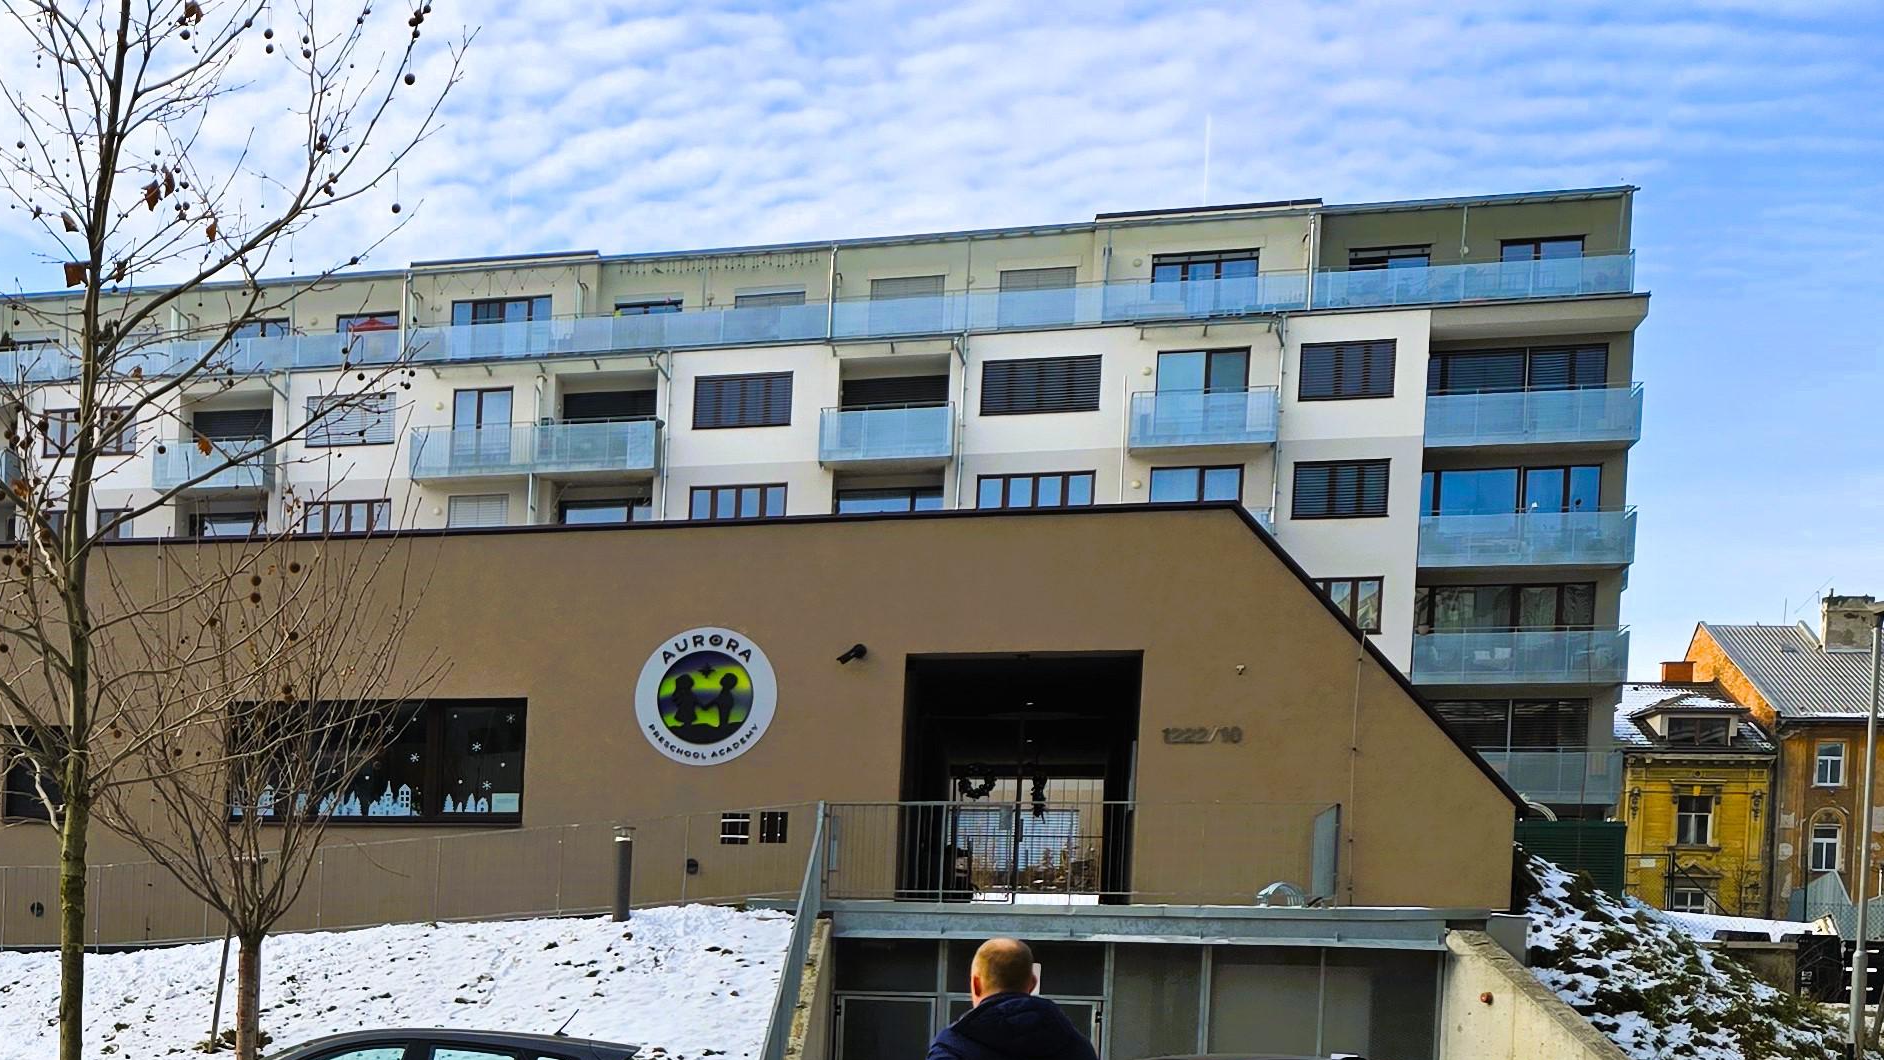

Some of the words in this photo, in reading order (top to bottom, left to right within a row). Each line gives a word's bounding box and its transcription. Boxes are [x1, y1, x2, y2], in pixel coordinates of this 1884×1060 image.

[662, 634, 752, 664] AURORA
[648, 724, 706, 759] PRESCHOOL
[710, 724, 759, 758] ACADEMY
